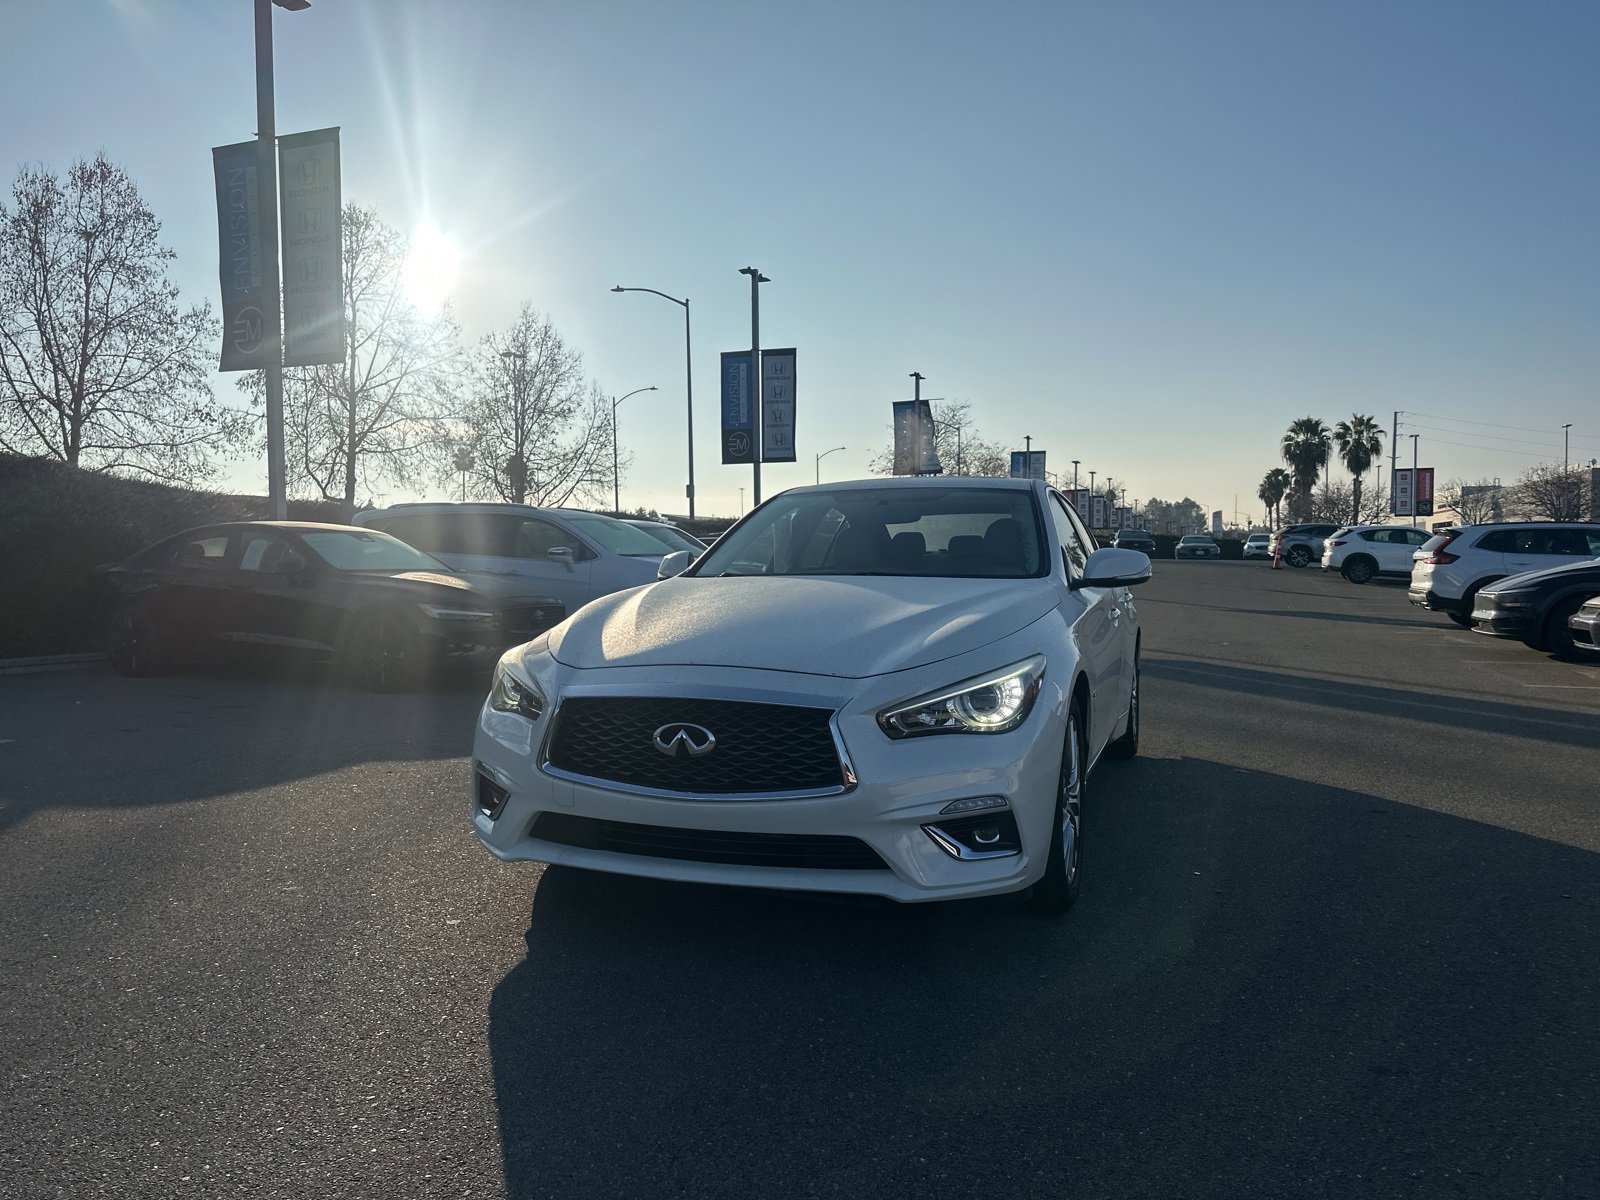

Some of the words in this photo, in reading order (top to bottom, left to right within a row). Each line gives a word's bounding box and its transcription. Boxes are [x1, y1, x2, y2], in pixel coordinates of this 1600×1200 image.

[288, 185, 331, 199] HONDA
[228, 167, 250, 292] ENVISION
[289, 234, 331, 247] HONDA
[728, 363, 739, 424] ENVISION
